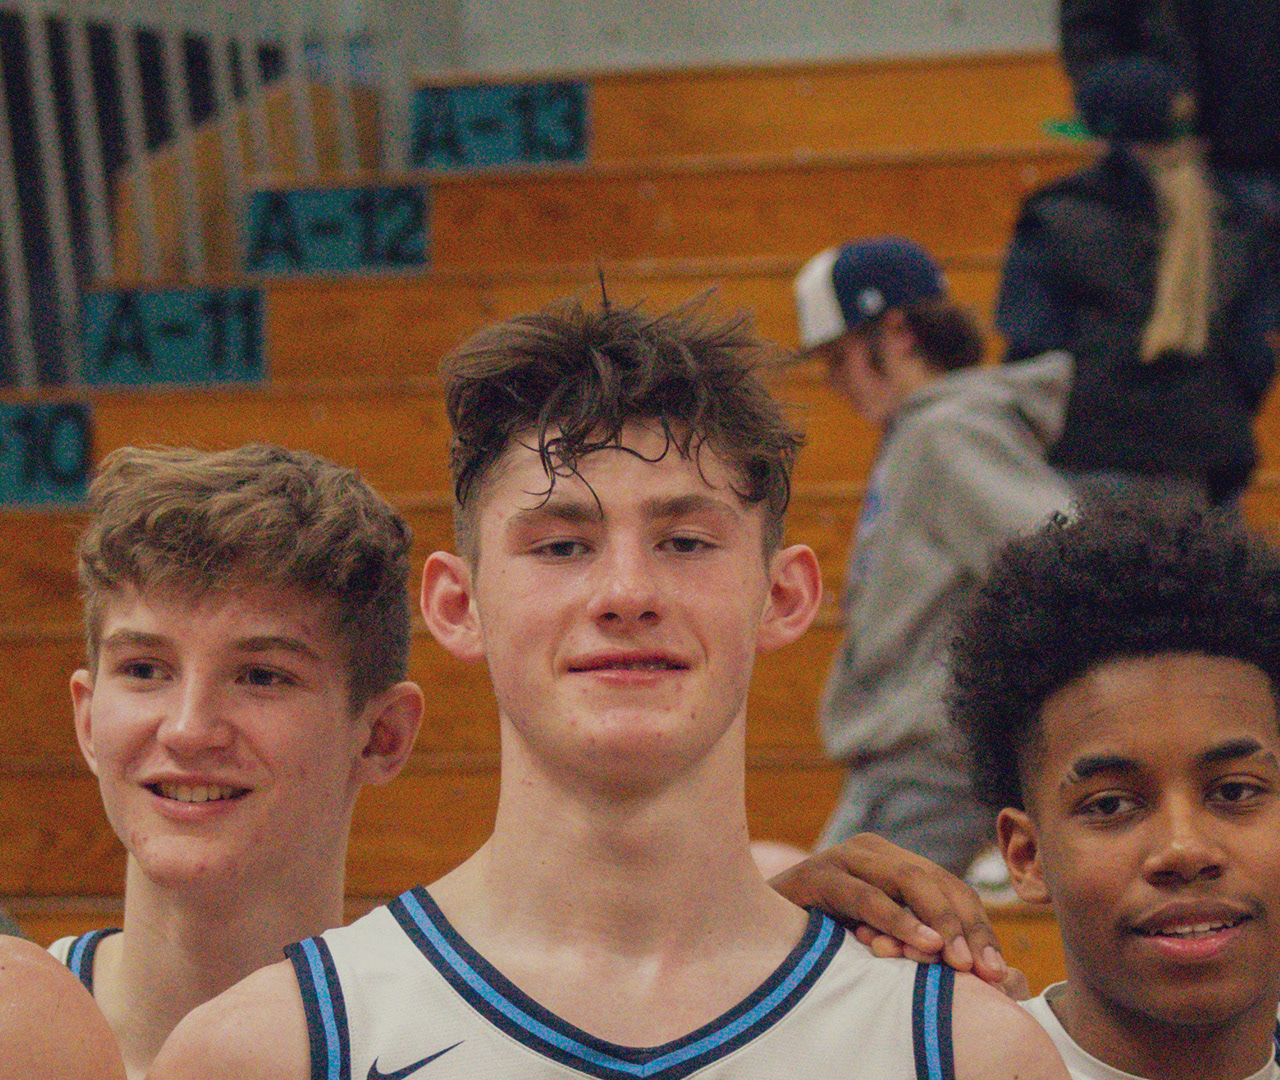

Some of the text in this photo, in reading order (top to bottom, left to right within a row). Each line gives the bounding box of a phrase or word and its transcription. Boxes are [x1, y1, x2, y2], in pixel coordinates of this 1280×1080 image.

[421, 87, 586, 161] A-13
[251, 188, 426, 267] A-12
[98, 290, 262, 369] A-11
